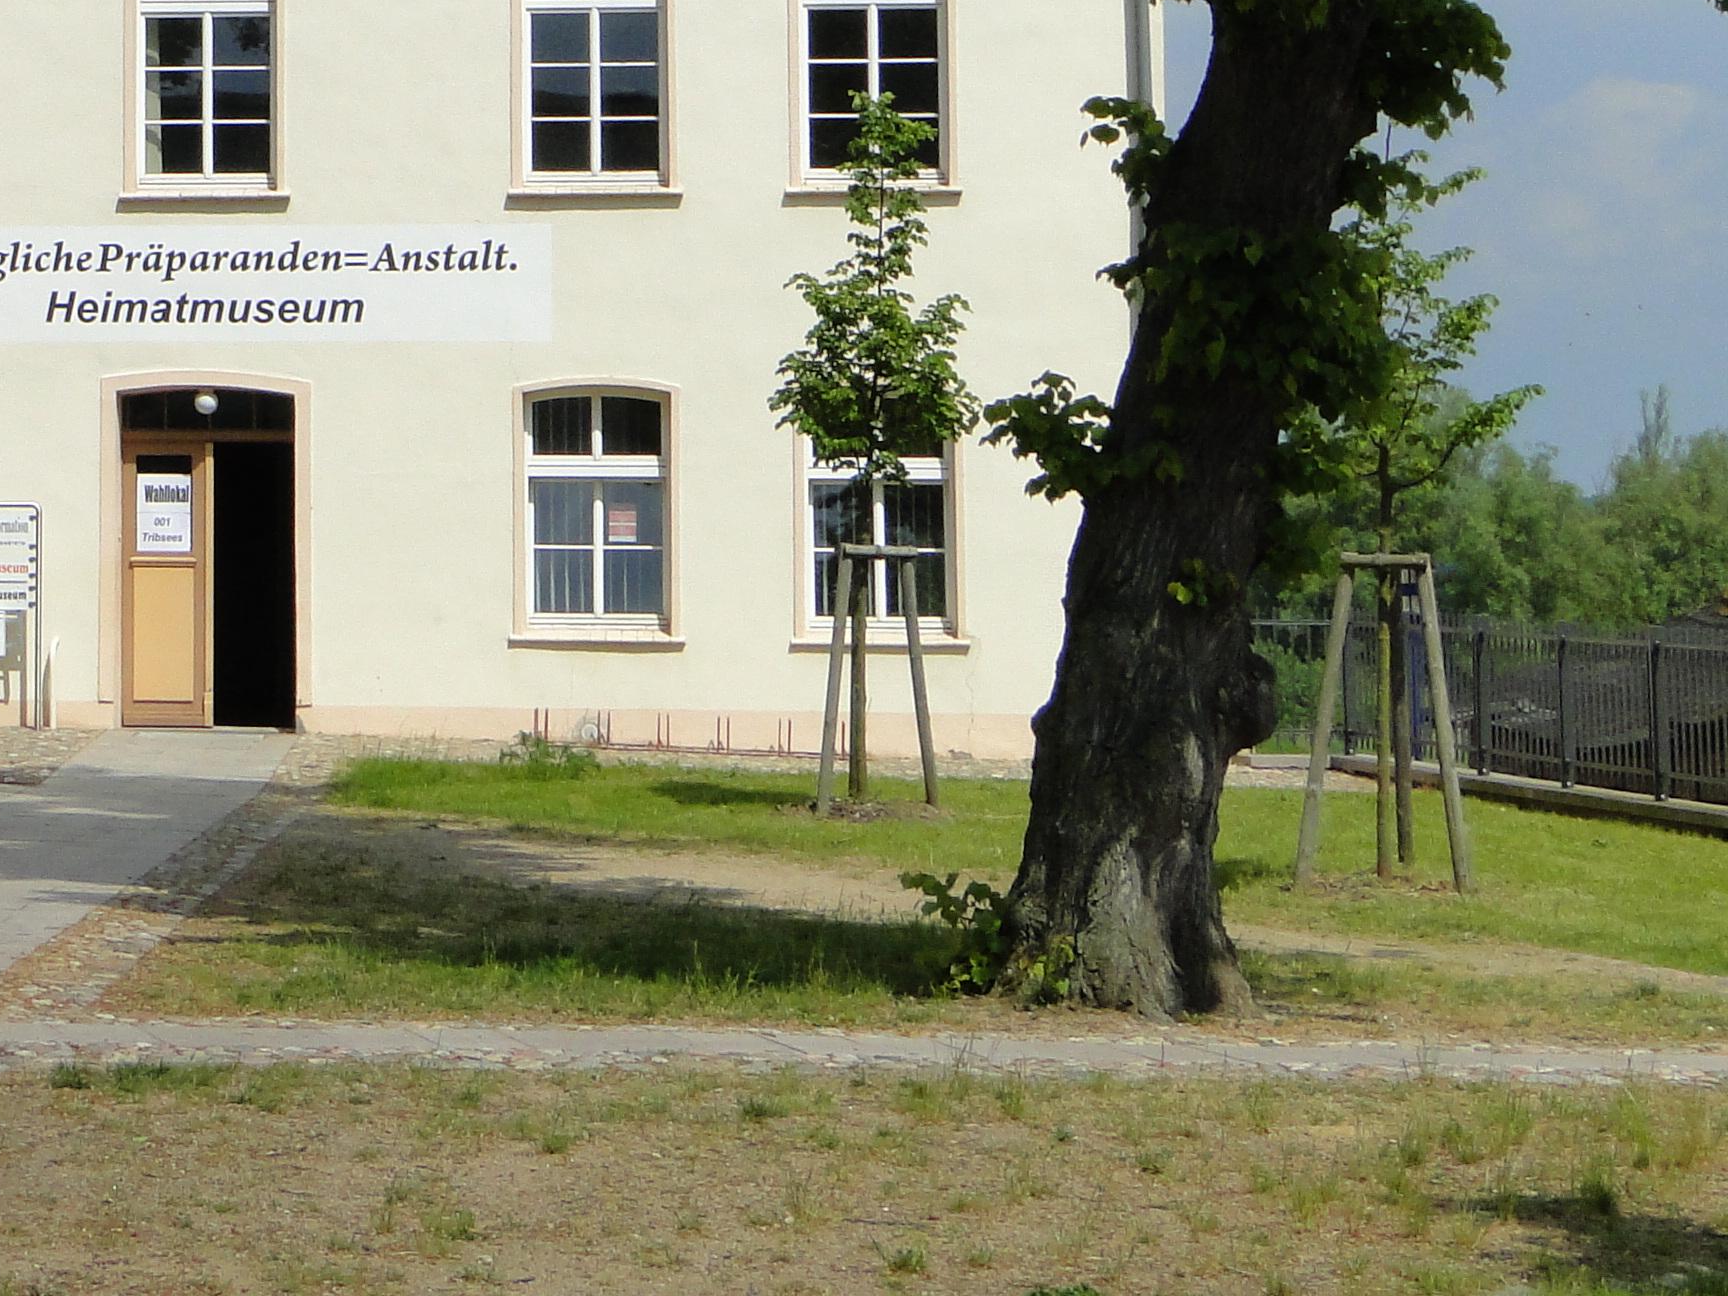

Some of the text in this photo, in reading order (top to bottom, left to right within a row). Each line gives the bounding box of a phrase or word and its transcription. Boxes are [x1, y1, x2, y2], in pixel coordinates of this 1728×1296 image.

[45, 290, 365, 324] Heimatmuseum
[144, 485, 189, 502] Wahllokal
[154, 517, 170, 526] 001
[143, 532, 183, 542] Tribsees
